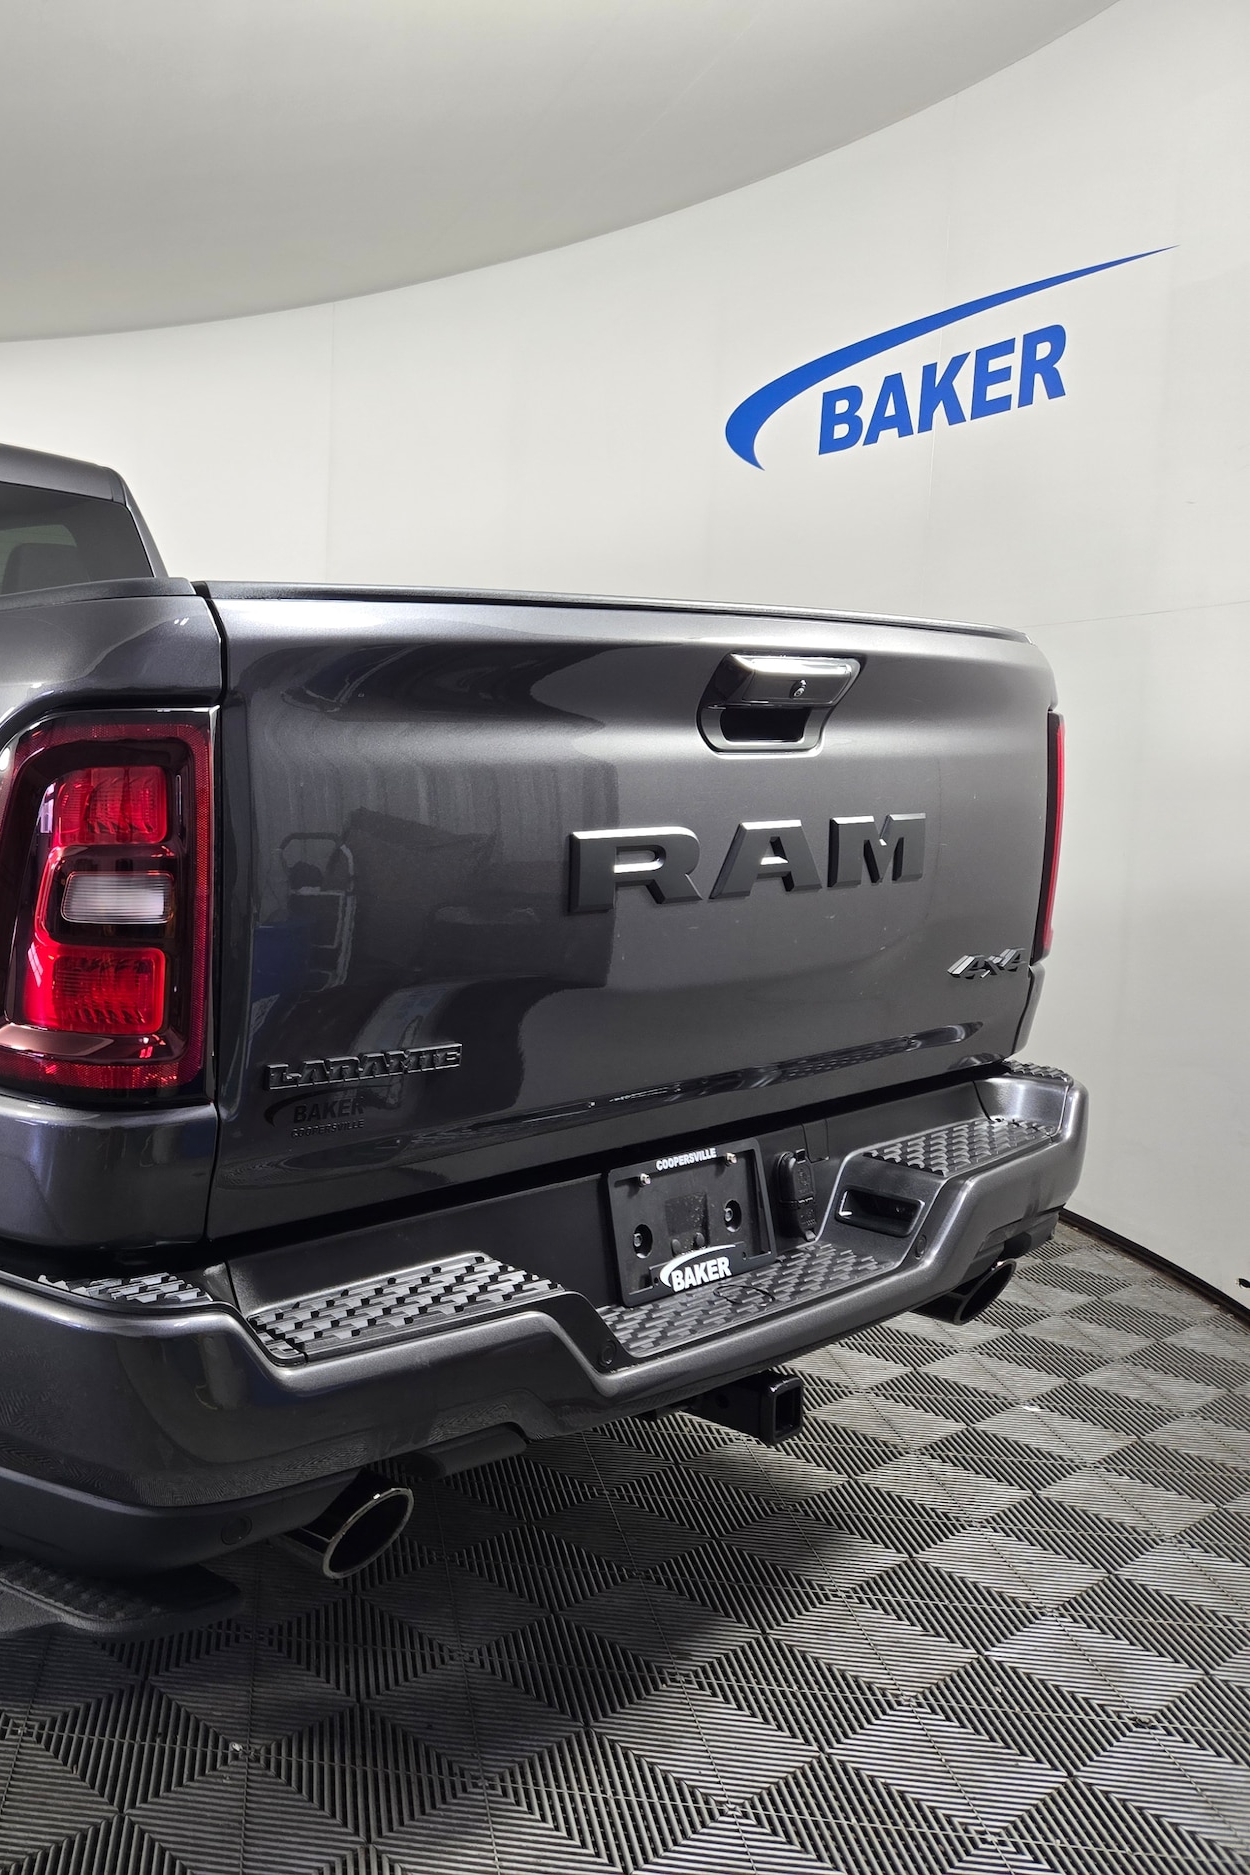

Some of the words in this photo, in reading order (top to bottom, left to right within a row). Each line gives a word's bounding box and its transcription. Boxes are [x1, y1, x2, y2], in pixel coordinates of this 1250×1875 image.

[819, 324, 1066, 455] BAKER
[568, 812, 926, 914] RAM
[265, 1043, 463, 1090] LARAMIE
[291, 1119, 365, 1138] COOPERSVILLE
[293, 1097, 365, 1124] BAKER
[656, 1148, 717, 1171] COOPERSVILLE
[671, 1256, 732, 1292] BAKER
